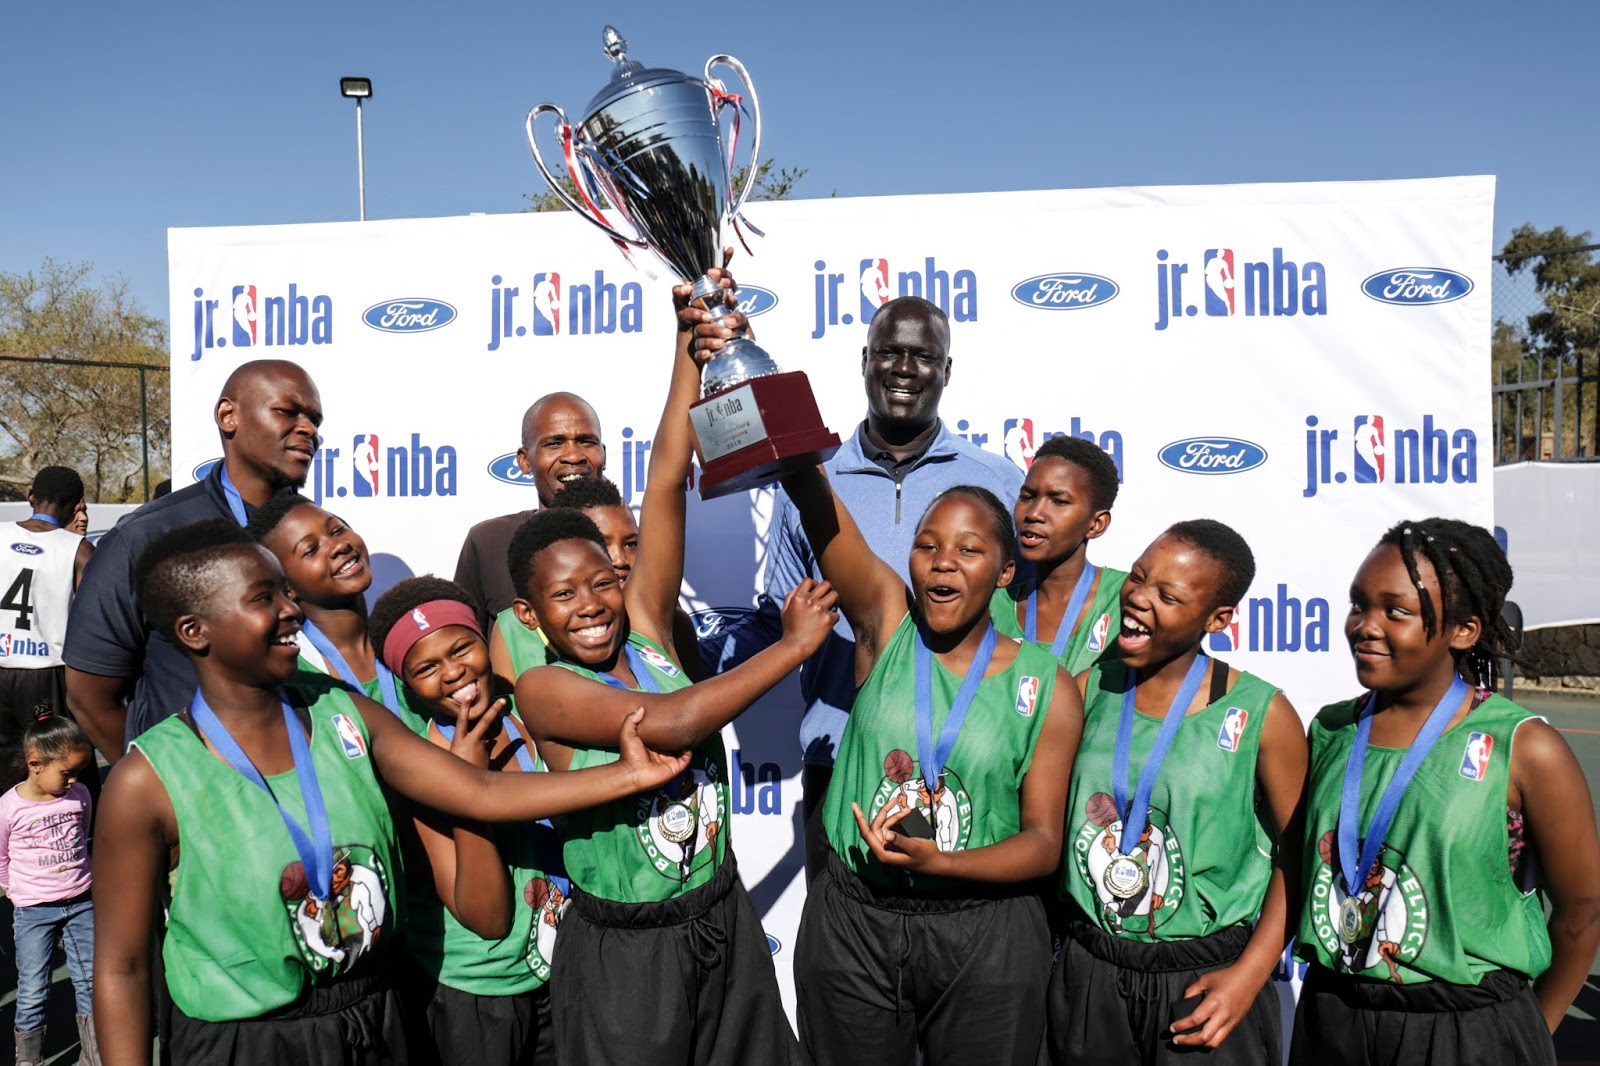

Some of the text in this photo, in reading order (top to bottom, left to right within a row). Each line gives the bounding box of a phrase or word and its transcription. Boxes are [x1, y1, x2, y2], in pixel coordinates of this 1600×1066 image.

[380, 302, 439, 327] Ford
[488, 270, 642, 351] jr. nba
[812, 260, 853, 339] jr.
[1033, 278, 1098, 303] Ford
[1155, 248, 1327, 330] jr. nba
[1384, 273, 1451, 298] Ford
[191, 284, 332, 361] jr. nba
[724, 398, 743, 417] nba
[314, 433, 456, 507] jr. nba
[622, 427, 651, 504] jr
[1180, 443, 1245, 467] Ford
[1303, 415, 1477, 498] jr. nba
[0, 567, 34, 631] 4
[1249, 583, 1329, 652] nba
[12, 638, 49, 656] nba
[731, 749, 782, 816] ba
[51, 826, 63, 837] IN
[956, 790, 971, 851] CELTI
[39, 849, 80, 866] MAKIN
[1076, 824, 1097, 888] OSTON
[1313, 867, 1340, 953] BOSTON
